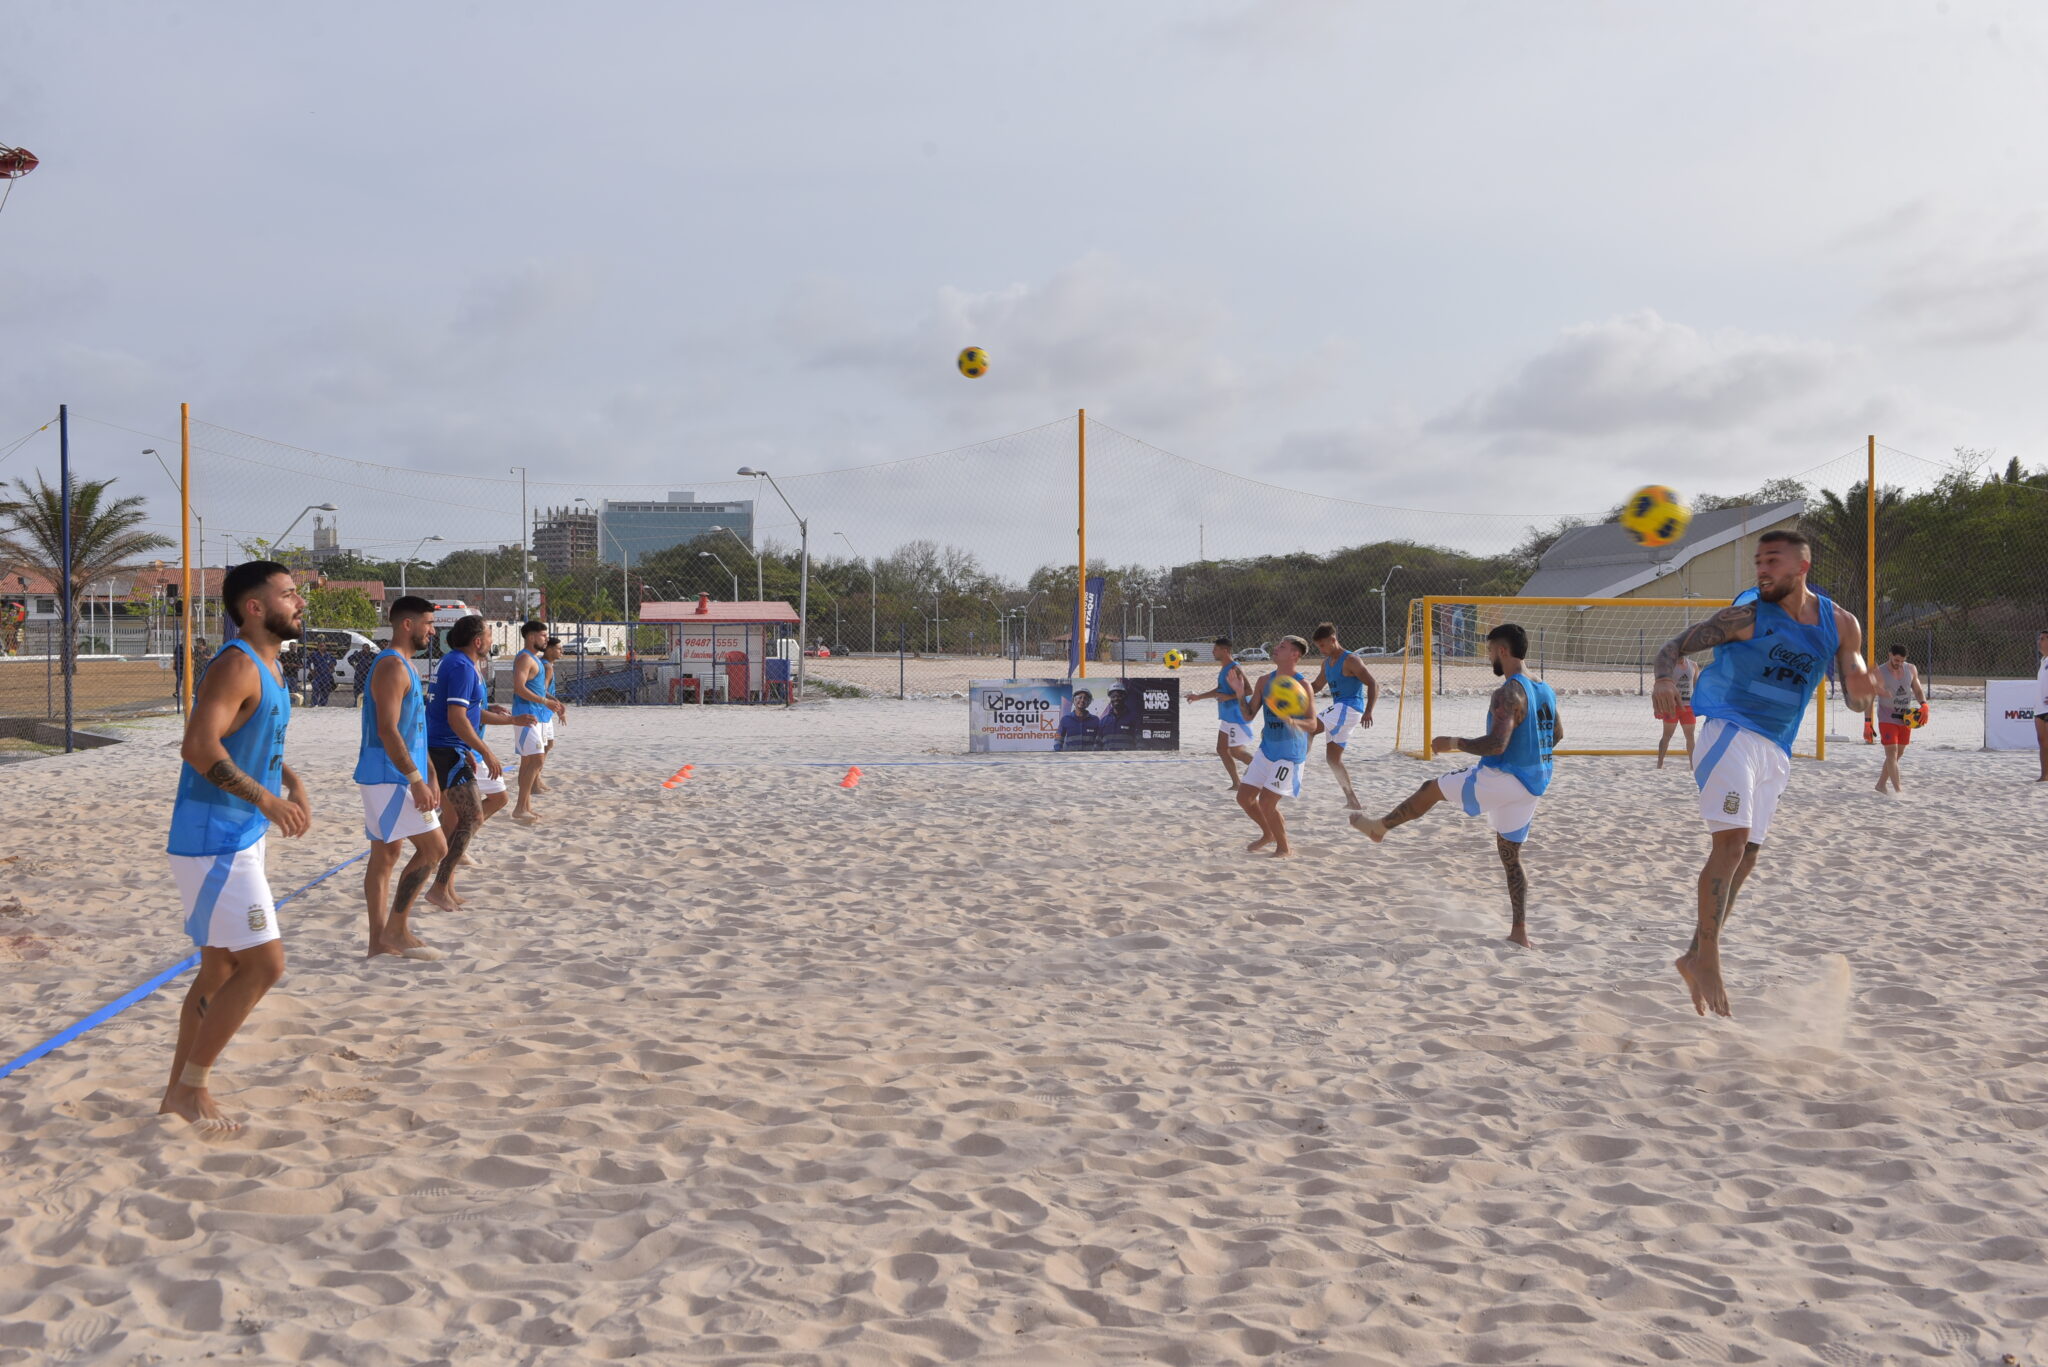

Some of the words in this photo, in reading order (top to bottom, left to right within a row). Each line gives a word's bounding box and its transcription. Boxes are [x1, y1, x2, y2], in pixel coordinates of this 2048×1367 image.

[1086, 592, 1095, 626] ITAQUI
[684, 638, 711, 647] 98487
[715, 638, 738, 647] 5555
[1004, 697, 1050, 710] Porto
[994, 711, 1040, 726] Itaqui
[981, 725, 1011, 733] orgulho
[996, 731, 1061, 740] maranhense
[1275, 765, 1289, 781] 10
